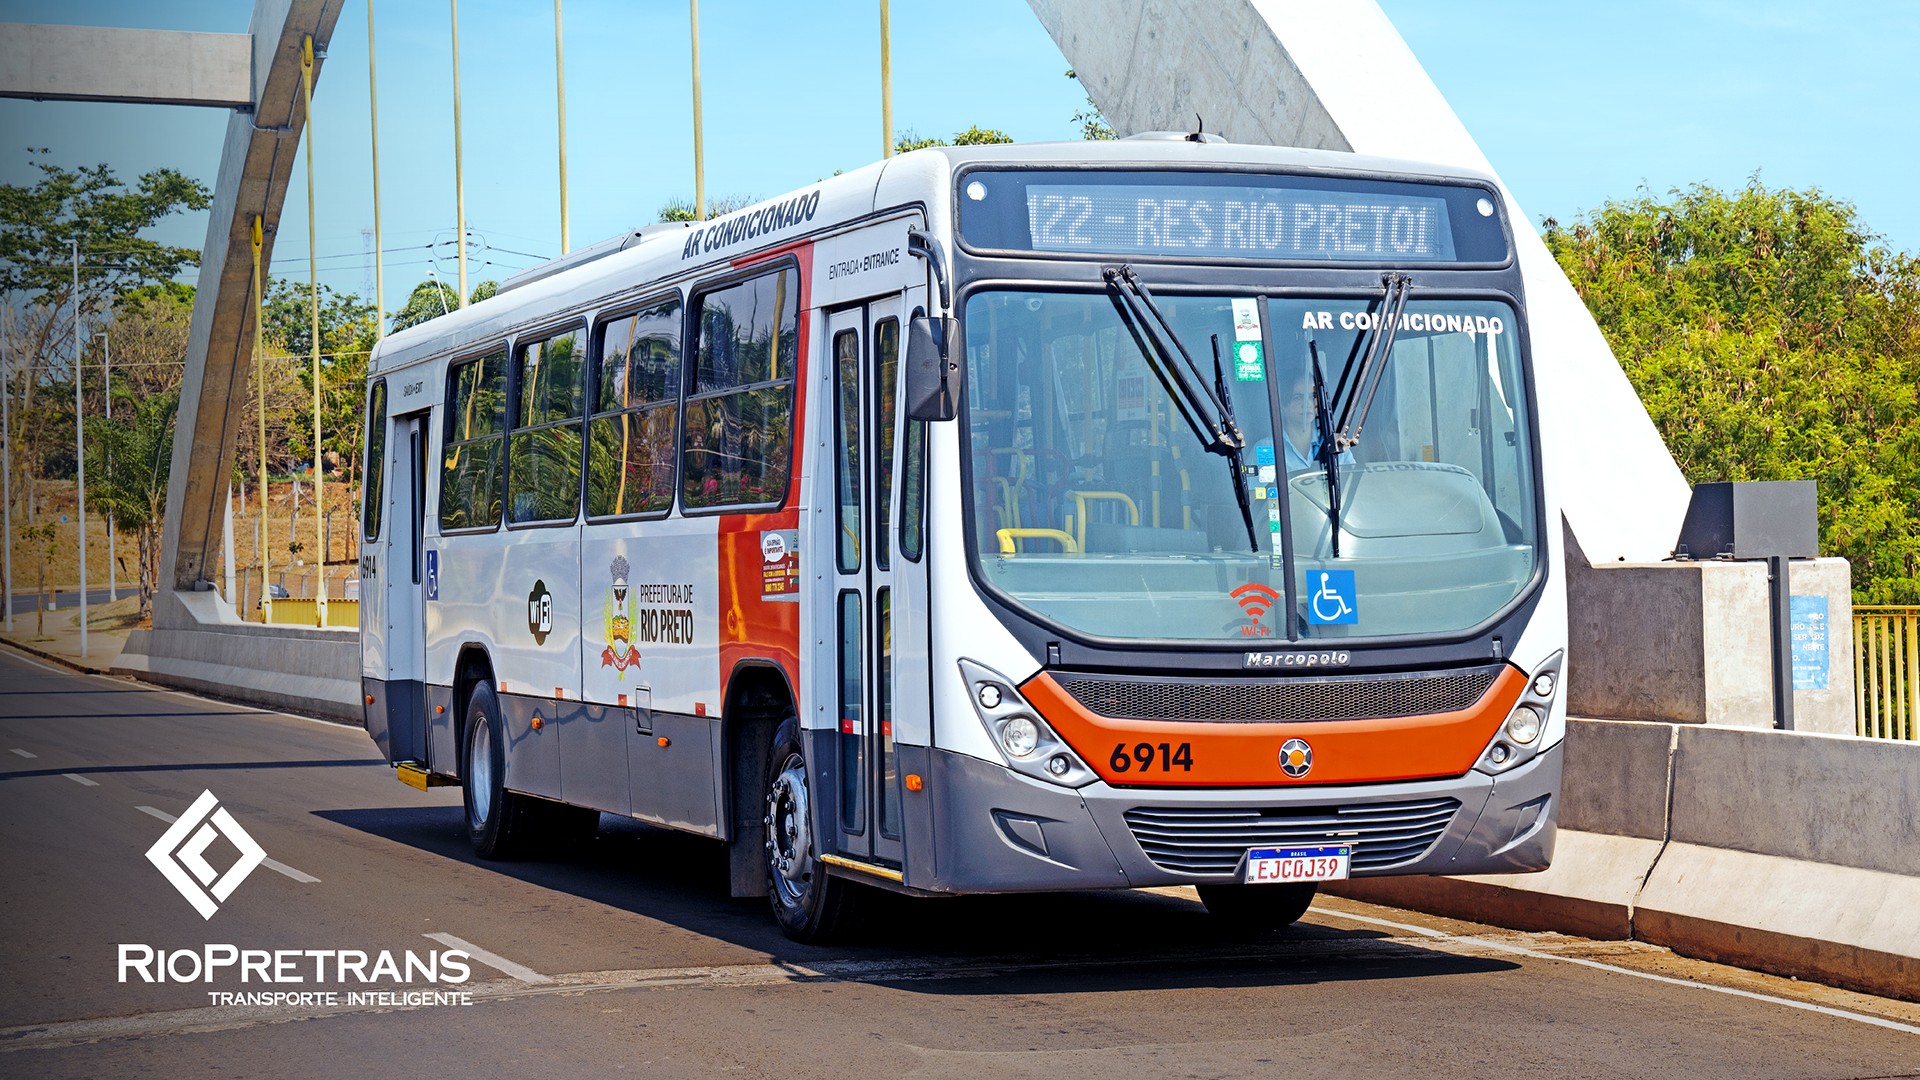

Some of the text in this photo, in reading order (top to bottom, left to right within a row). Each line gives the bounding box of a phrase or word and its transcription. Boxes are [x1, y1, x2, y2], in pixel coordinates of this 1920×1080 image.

[681, 189, 821, 260] AR CONDICIONADO
[1027, 195, 1093, 244] 122
[1137, 198, 1213, 247] RES
[1223, 201, 1283, 249] RIO
[1302, 311, 1334, 330] AR
[640, 584, 693, 604] PREFEITURA DE
[640, 608, 694, 645] RIO PRETO
[1246, 651, 1349, 667] Marcopolo
[1109, 742, 1194, 773] 6914
